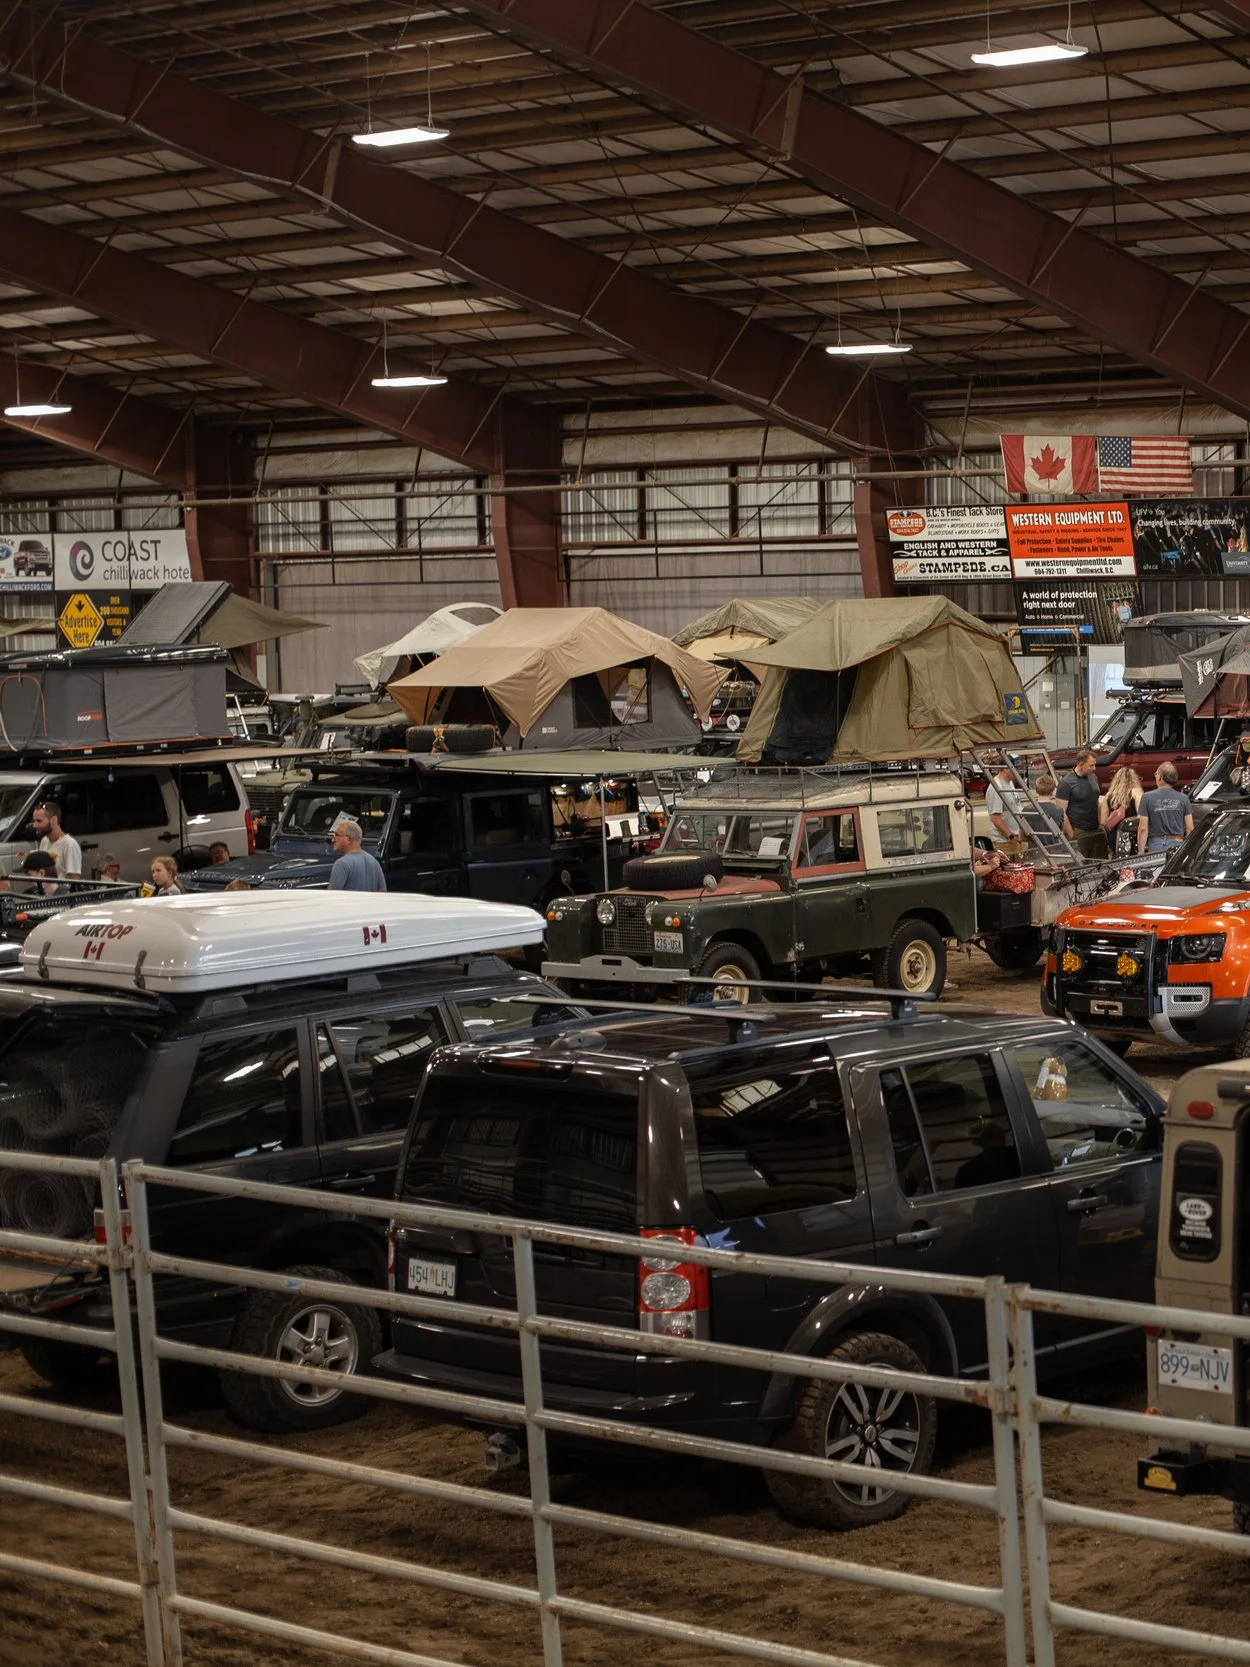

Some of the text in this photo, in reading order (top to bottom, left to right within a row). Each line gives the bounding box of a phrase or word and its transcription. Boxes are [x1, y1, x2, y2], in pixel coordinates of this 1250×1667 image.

[947, 507, 967, 517] Finest
[969, 507, 984, 516] Tack
[985, 506, 1004, 516] Store
[1011, 510, 1125, 526] WESTERN EQUIPMENT LTD.
[1178, 519, 1202, 527] building
[1202, 518, 1236, 526] community.
[101, 539, 161, 562] COAST
[904, 541, 997, 550] ENGLISH AND WESTERN
[917, 549, 939, 557] TACK
[948, 548, 985, 556] APPAREL
[1024, 558, 1123, 567] www.westernequipmentltd.com
[103, 564, 190, 581] chilliwack hote
[1022, 590, 1097, 600] A world of protection
[1023, 601, 1040, 610] right
[1058, 600, 1075, 608] door
[64, 615, 98, 628] Advertise
[73, 630, 90, 643] Here
[74, 923, 134, 939] AIRTOP
[410, 1264, 454, 1289] 454 LHJ
[1160, 1352, 1190, 1377] 899
[1200, 1358, 1230, 1383] NJV
